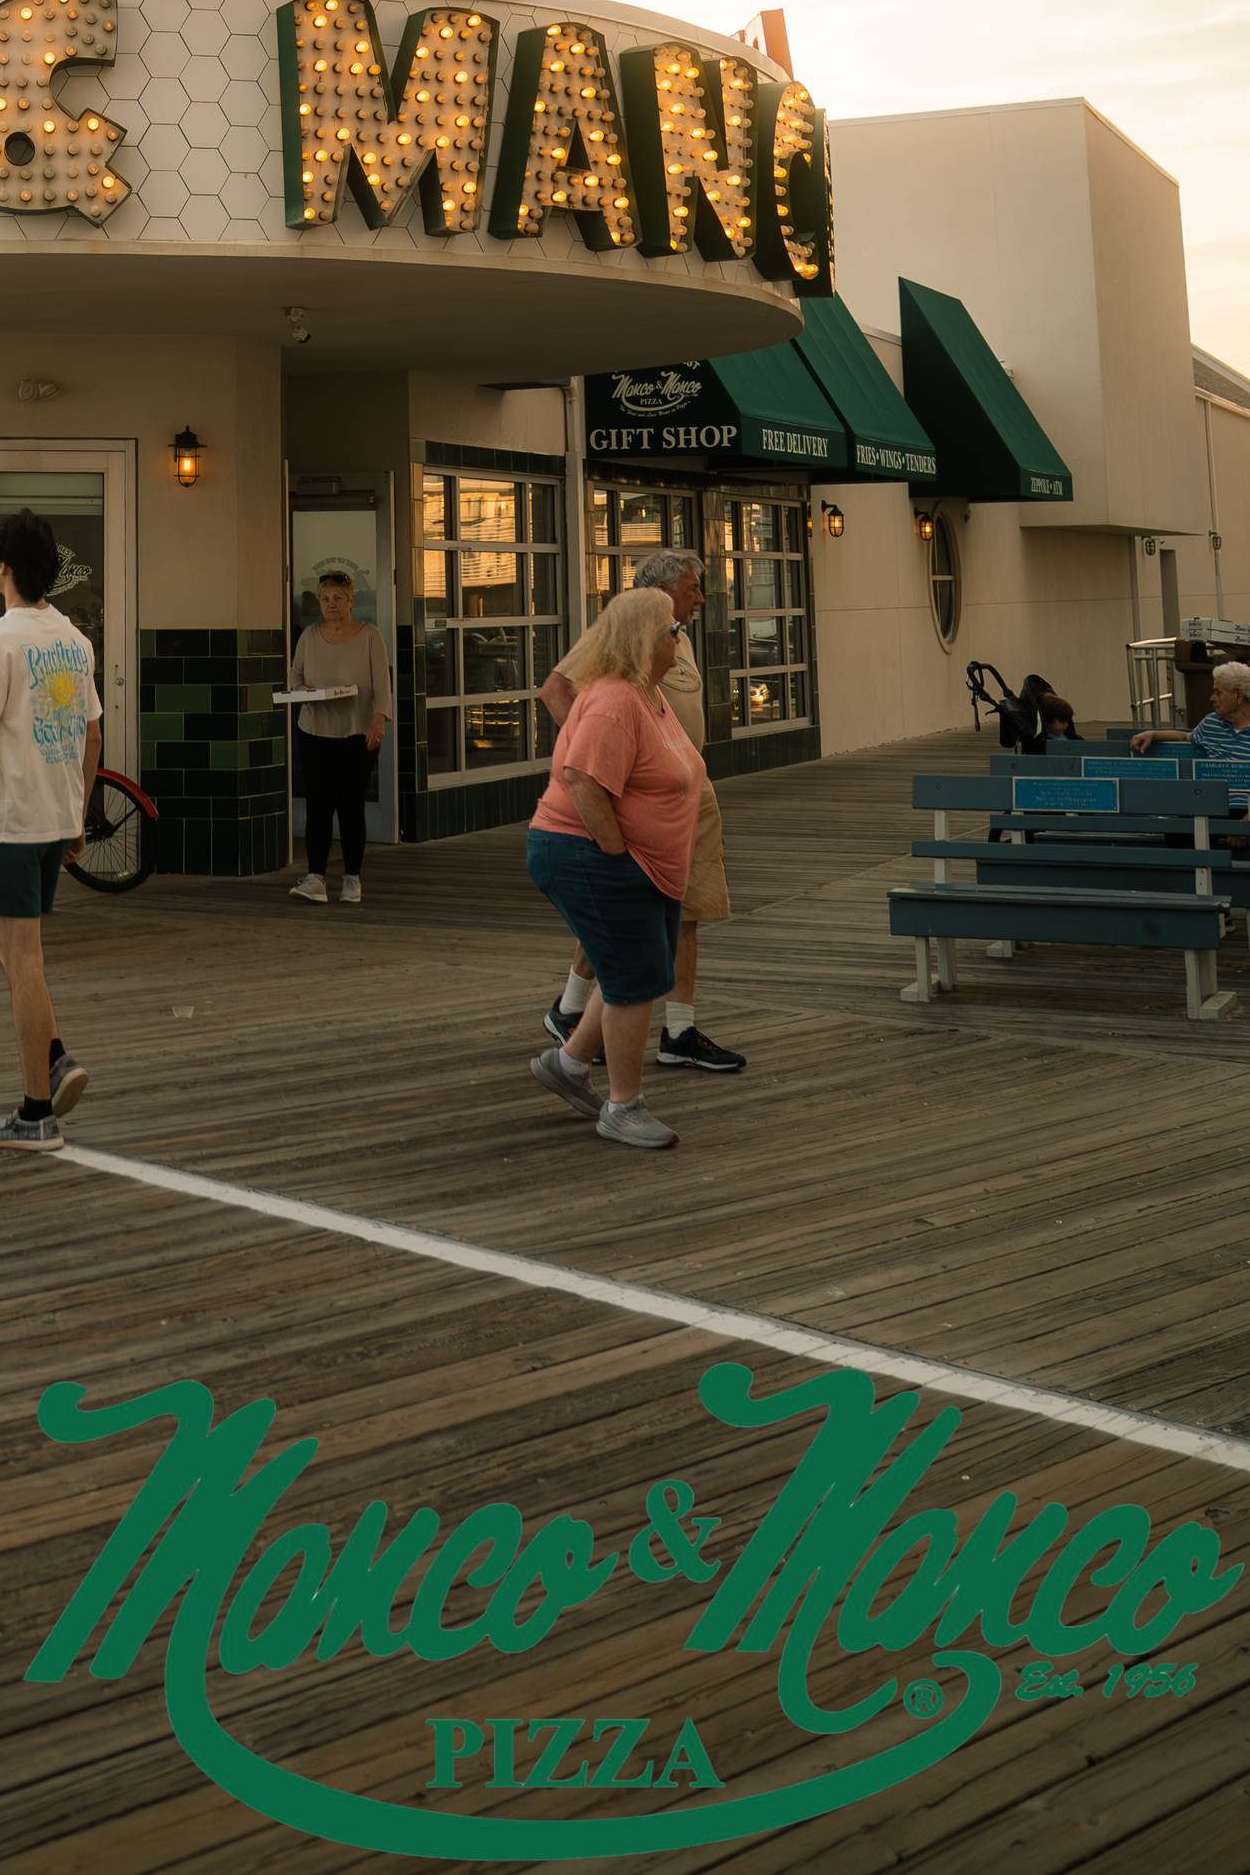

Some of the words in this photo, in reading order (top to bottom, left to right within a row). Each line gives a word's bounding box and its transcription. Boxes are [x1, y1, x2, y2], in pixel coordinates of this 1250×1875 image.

[655, 380, 663, 390] &
[640, 398, 663, 406] PIZZA
[589, 428, 655, 451] GIFT
[662, 425, 738, 450] SHOP
[761, 428, 786, 453] FREE
[786, 432, 829, 458] DELIVERY
[856, 444, 877, 466] FRIES
[879, 448, 902, 470] WINGS
[905, 453, 937, 475] TENDERS
